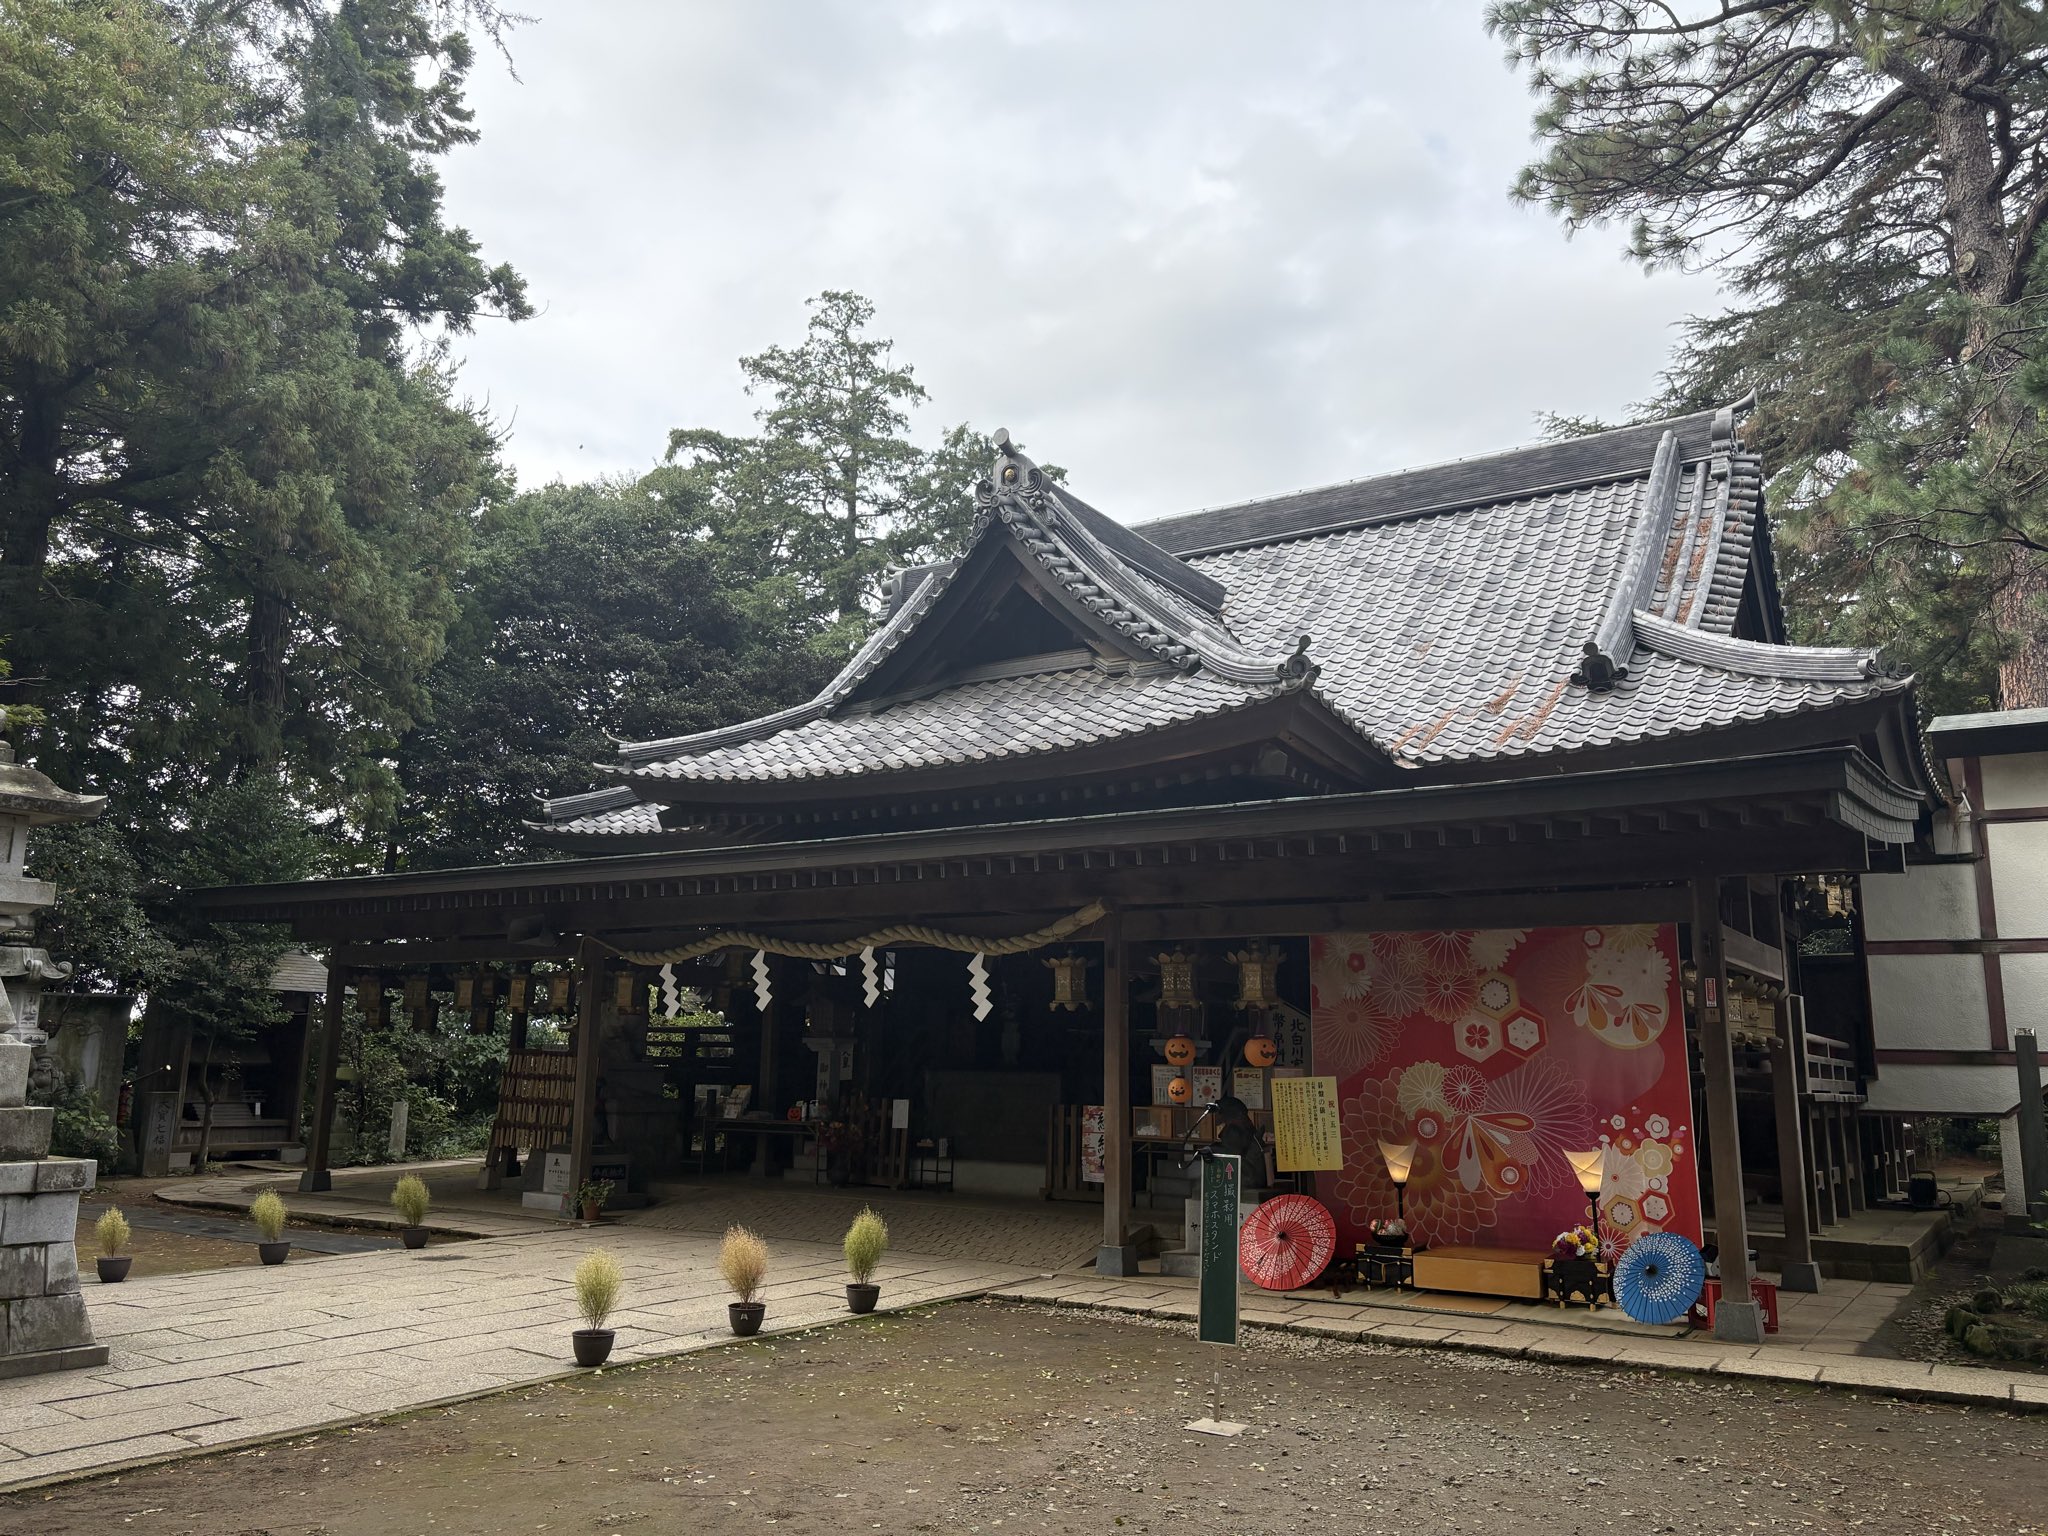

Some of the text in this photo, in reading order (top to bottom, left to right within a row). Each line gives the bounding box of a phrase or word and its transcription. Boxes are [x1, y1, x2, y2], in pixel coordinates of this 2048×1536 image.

[1209, 1190, 1223, 1263] スマホスタンド
[1223, 1183, 1236, 1226] 撮影用
